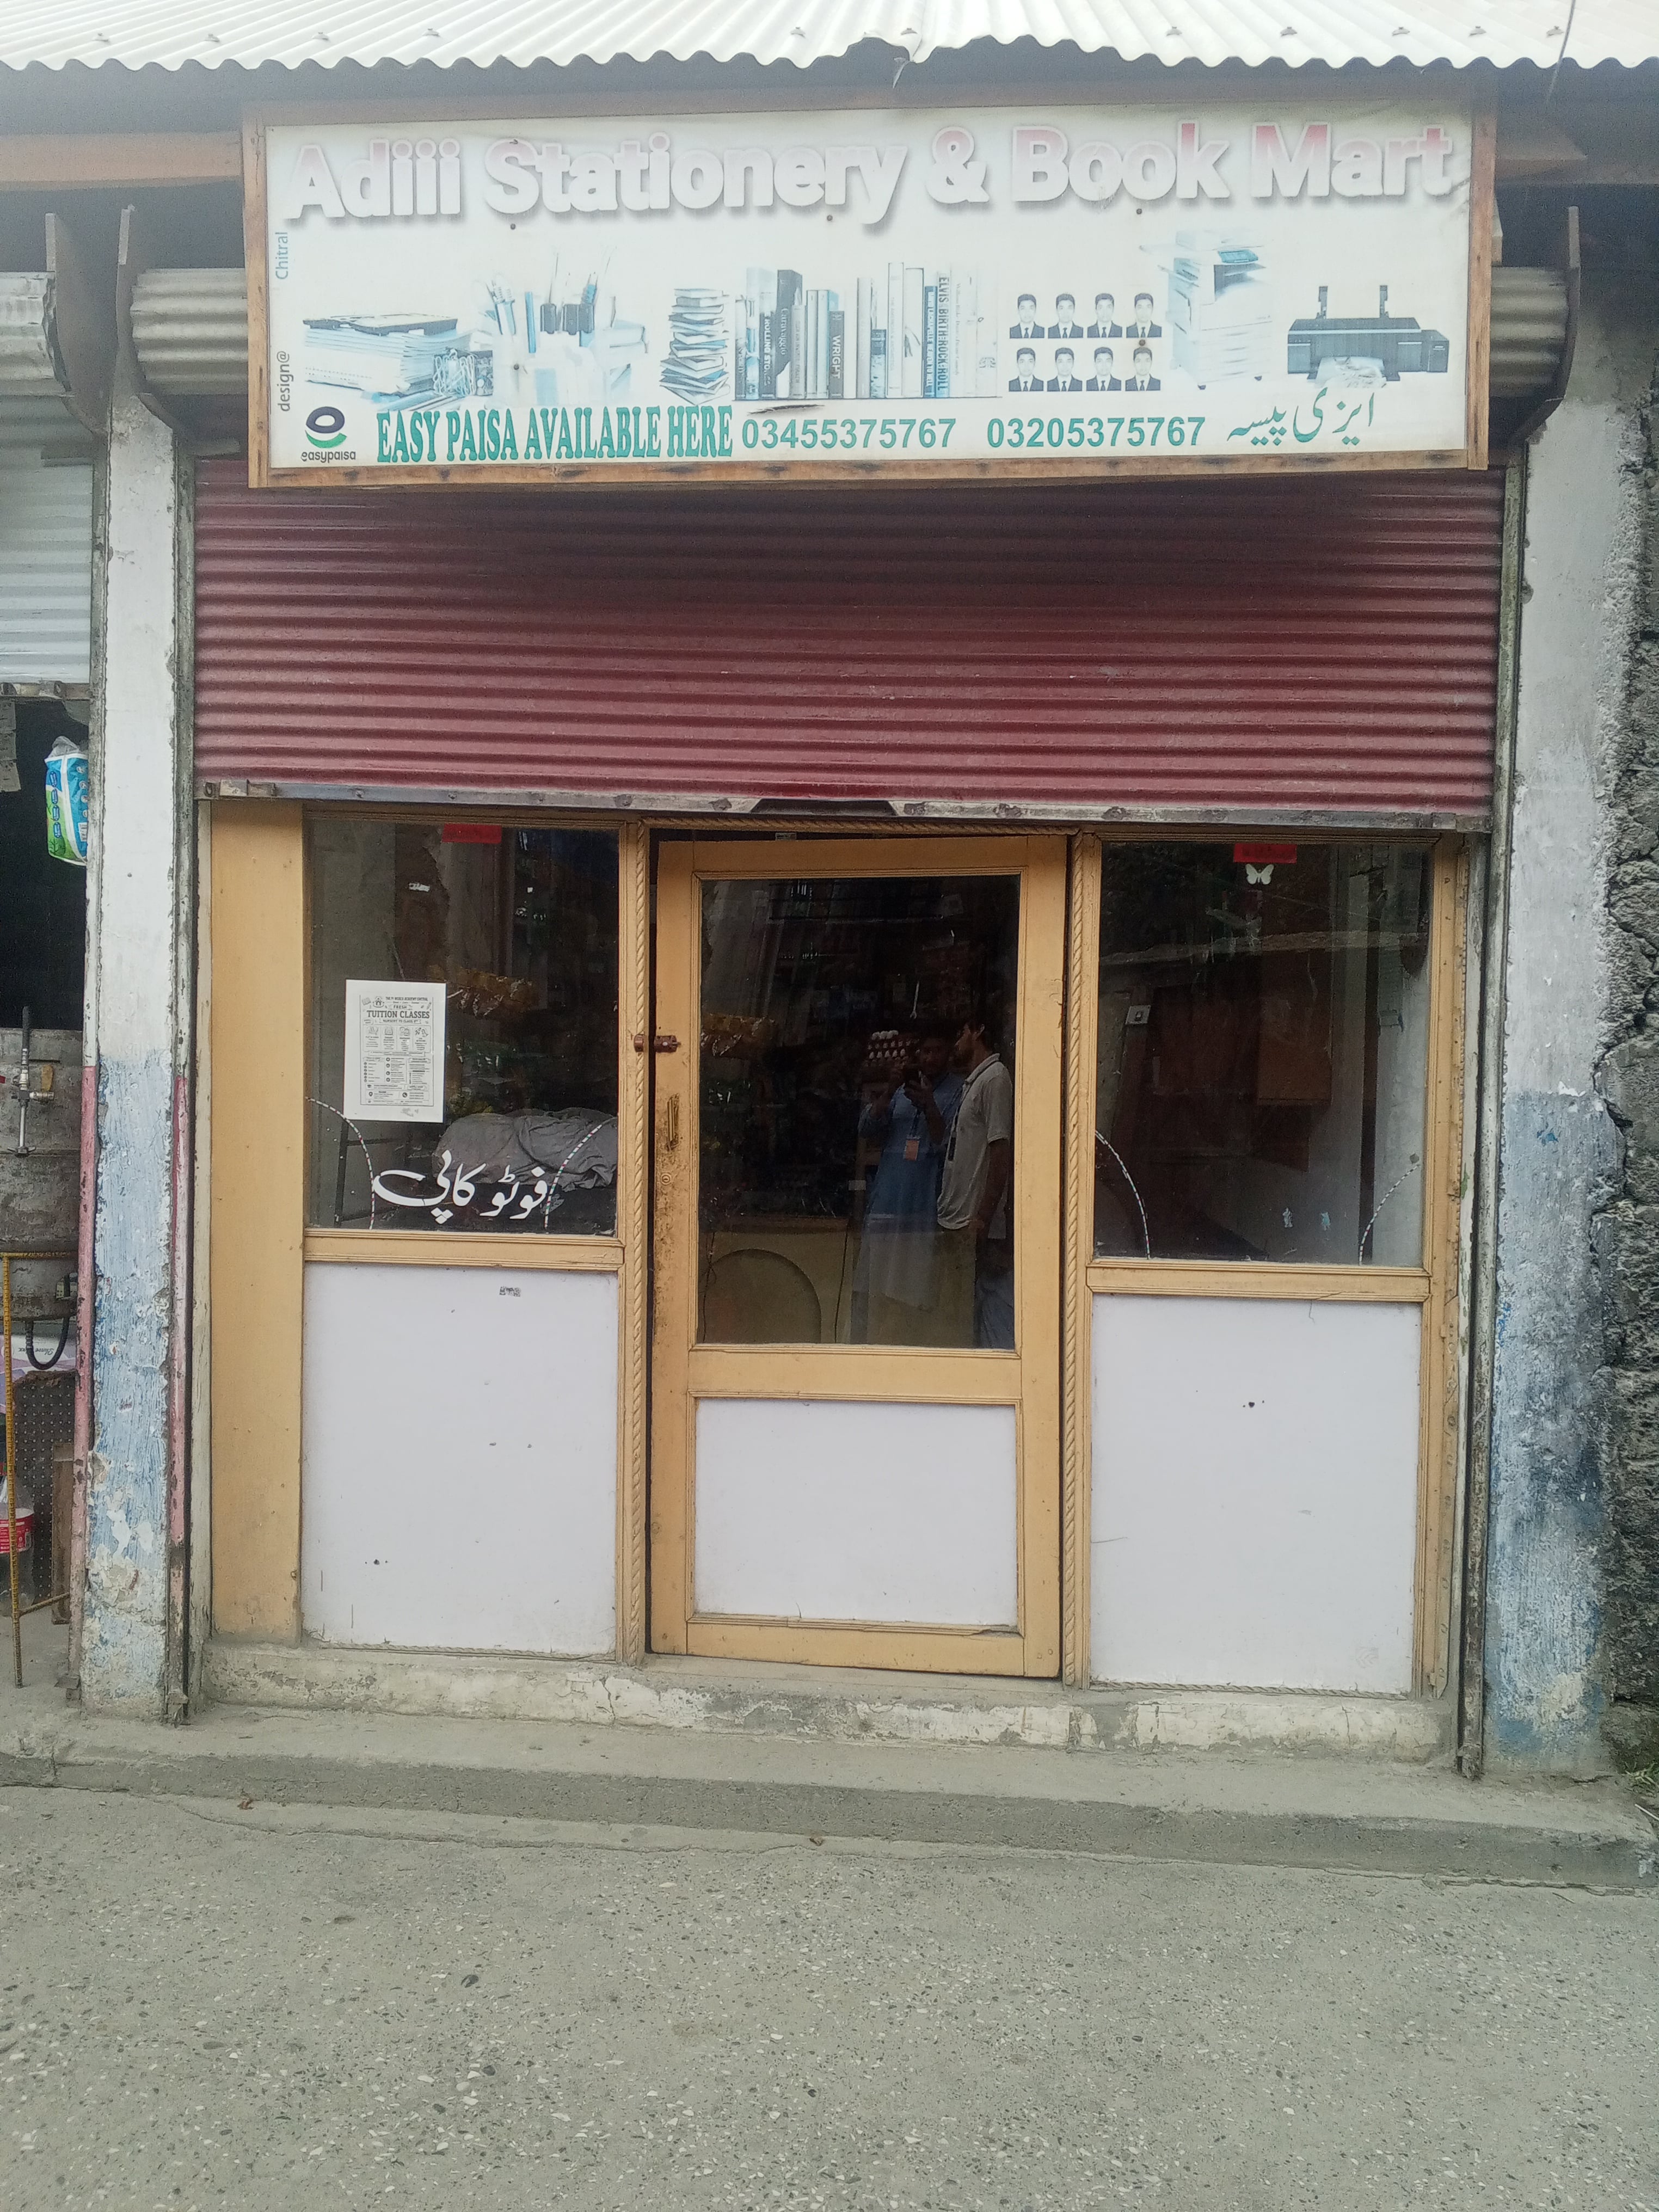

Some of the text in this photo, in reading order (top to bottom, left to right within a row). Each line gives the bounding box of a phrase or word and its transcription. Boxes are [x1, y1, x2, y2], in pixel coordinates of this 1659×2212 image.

[484, 131, 908, 225] Stationery
[926, 125, 990, 204] &
[1011, 119, 1230, 201] Book
[1252, 121, 1453, 198] Mart
[938, 277, 949, 303] ELVIS
[275, 232, 293, 412] design@ Chitral
[832, 335, 841, 379] WRIGHT
[377, 405, 733, 463] EASY PAISA AVAILABLE HERE
[742, 418, 956, 448] 03455375767
[987, 416, 1206, 448] 03205375767
[1293, 387, 1375, 446] ایزی
[300, 450, 357, 463] easypaisa
[366, 1010, 430, 1018] TUITION CLASSES
[372, 1149, 548, 1225] فوٹو کاپی
